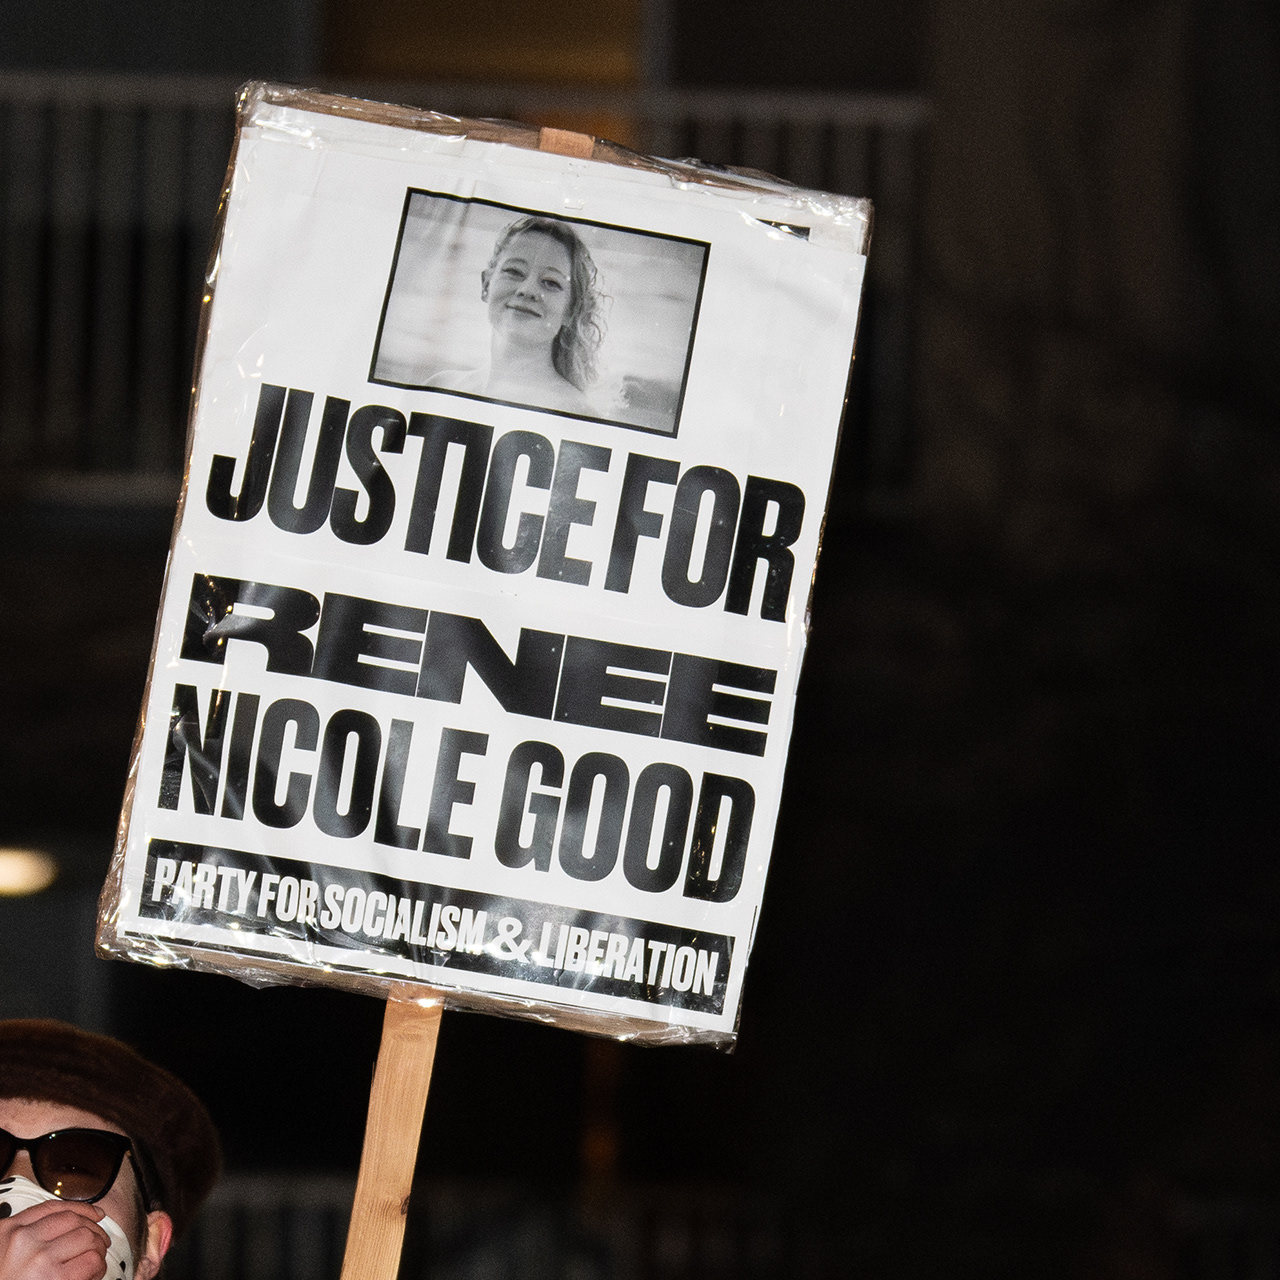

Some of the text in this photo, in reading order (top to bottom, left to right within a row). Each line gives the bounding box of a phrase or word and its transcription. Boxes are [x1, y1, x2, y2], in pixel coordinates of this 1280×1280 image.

[206, 383, 807, 624] JUSTICE FOR
[180, 573, 778, 757] RENEE
[158, 682, 756, 904] NICOLE GOOD
[152, 857, 720, 996] PARTY FOR SOCIALISM & LIBERATION
